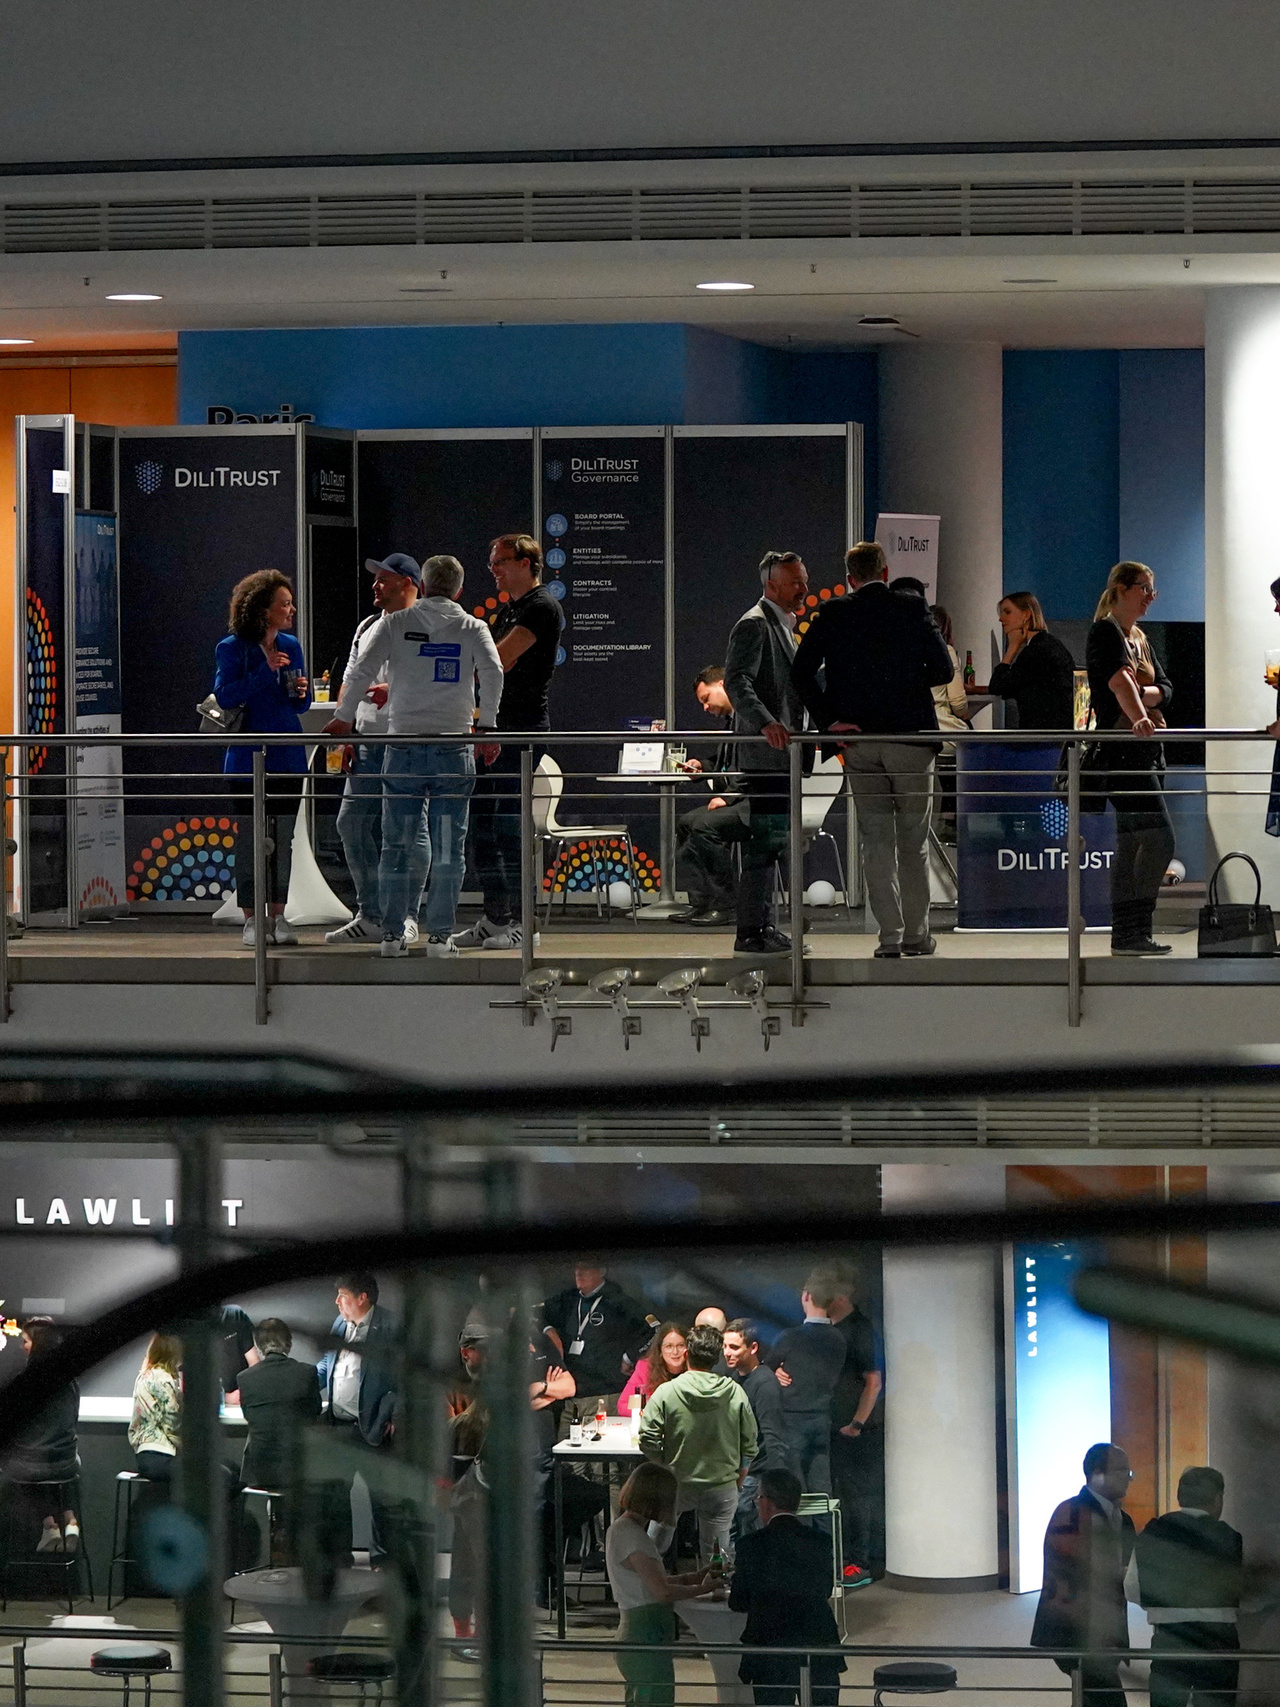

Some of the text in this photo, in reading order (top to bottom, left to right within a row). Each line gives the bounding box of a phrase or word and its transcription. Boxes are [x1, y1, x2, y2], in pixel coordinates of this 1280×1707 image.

[571, 471, 639, 483] Governance
[15, 1197, 243, 1226] LAWLIT
[1025, 1257, 1038, 1358] LAWLIFT
